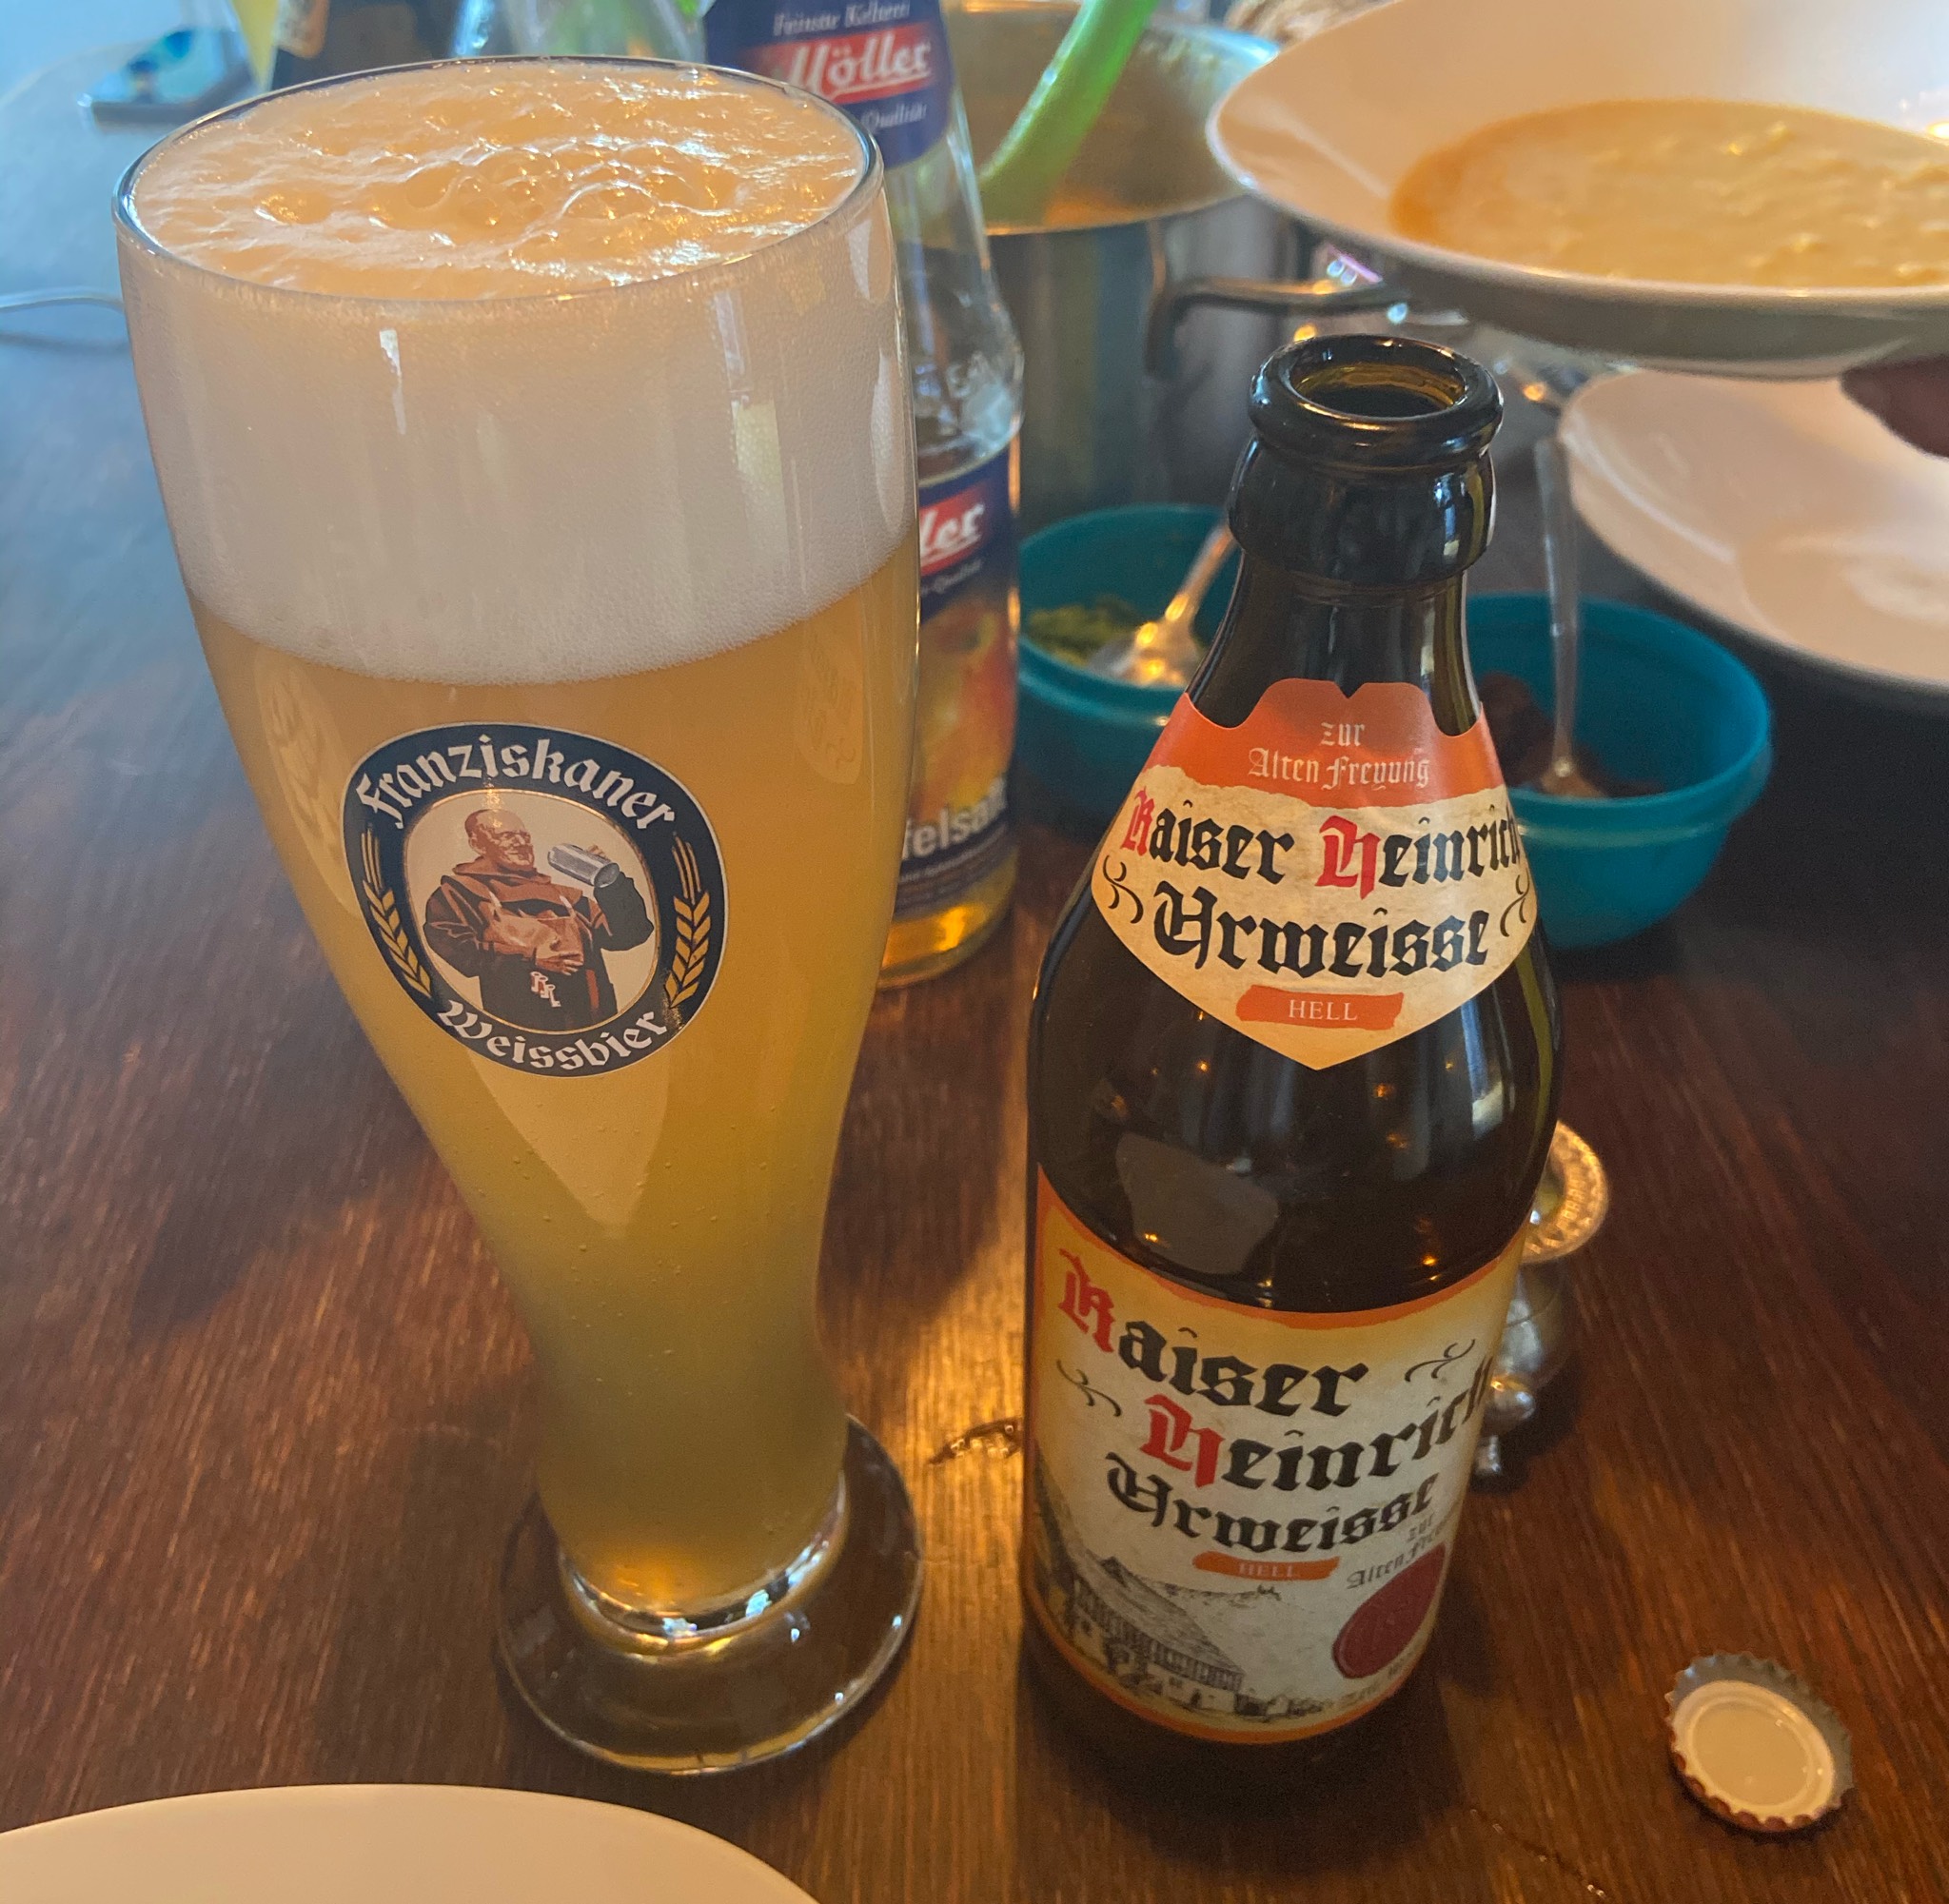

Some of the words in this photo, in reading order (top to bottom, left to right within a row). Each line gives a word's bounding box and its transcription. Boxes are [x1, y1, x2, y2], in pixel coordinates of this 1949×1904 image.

[919, 502, 986, 557] ler
[1248, 747, 1319, 783] Alten
[1320, 721, 1365, 747] zur
[356, 734, 676, 831] Franziskaner
[1120, 790, 1295, 885] Kaiser
[1152, 880, 1490, 978] Urweisse
[436, 999, 668, 1070] Weissbier
[1288, 998, 1359, 1022] HELL
[1057, 1247, 1369, 1418] Kaiser
[1105, 1451, 1440, 1553] Urweisse
[1238, 1561, 1298, 1580] HELL
